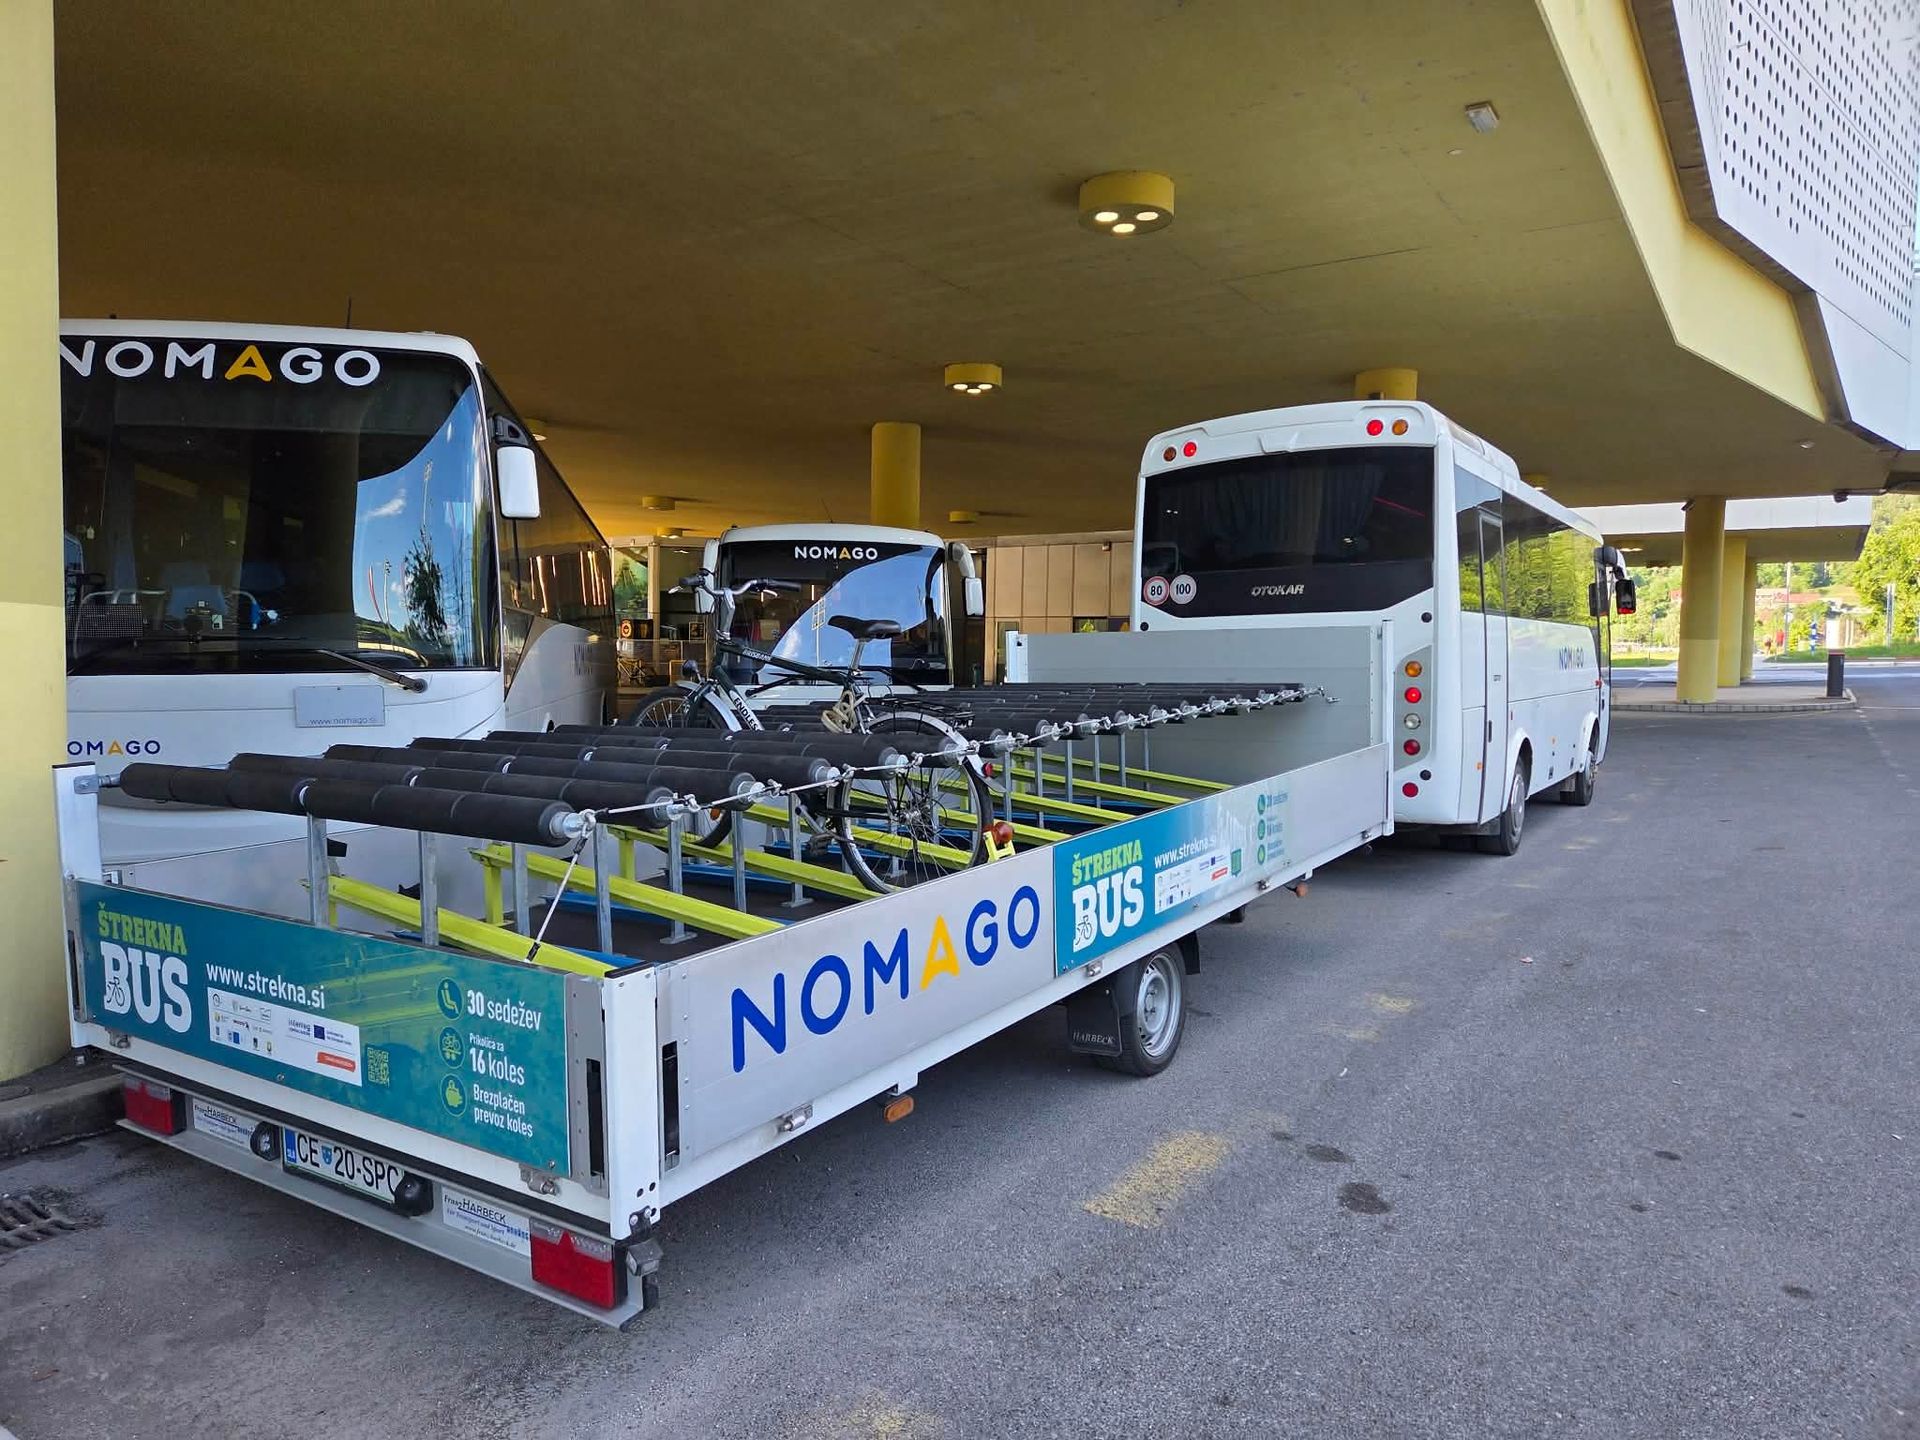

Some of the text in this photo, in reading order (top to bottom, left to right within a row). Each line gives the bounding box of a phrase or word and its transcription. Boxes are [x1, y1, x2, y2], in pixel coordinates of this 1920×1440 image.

[60, 339, 381, 387] NOMAGO
[794, 545, 878, 560] NOMAGO
[1150, 585, 1163, 596] 80
[1175, 583, 1191, 595] 100
[1251, 584, 1305, 597] OTOKAR
[733, 697, 759, 730] ENDLES
[67, 740, 161, 756] OMAGO
[1072, 839, 1144, 886] ŠTREKNA
[1072, 865, 1145, 953] BUS
[98, 902, 187, 956] ŠTREKNA
[101, 941, 192, 1033] BUS
[206, 962, 326, 1010] www.strekna.si
[731, 885, 1040, 1073] NOMAGO
[467, 989, 542, 1031] 30 sedežev
[469, 1032, 505, 1052] Prikolica za
[469, 1047, 525, 1086] 16 koles
[473, 1084, 526, 1116] Brezplačen
[474, 1106, 534, 1138] prevoz koles
[297, 1133, 320, 1168] CE
[462, 1198, 507, 1224] HARBECK
